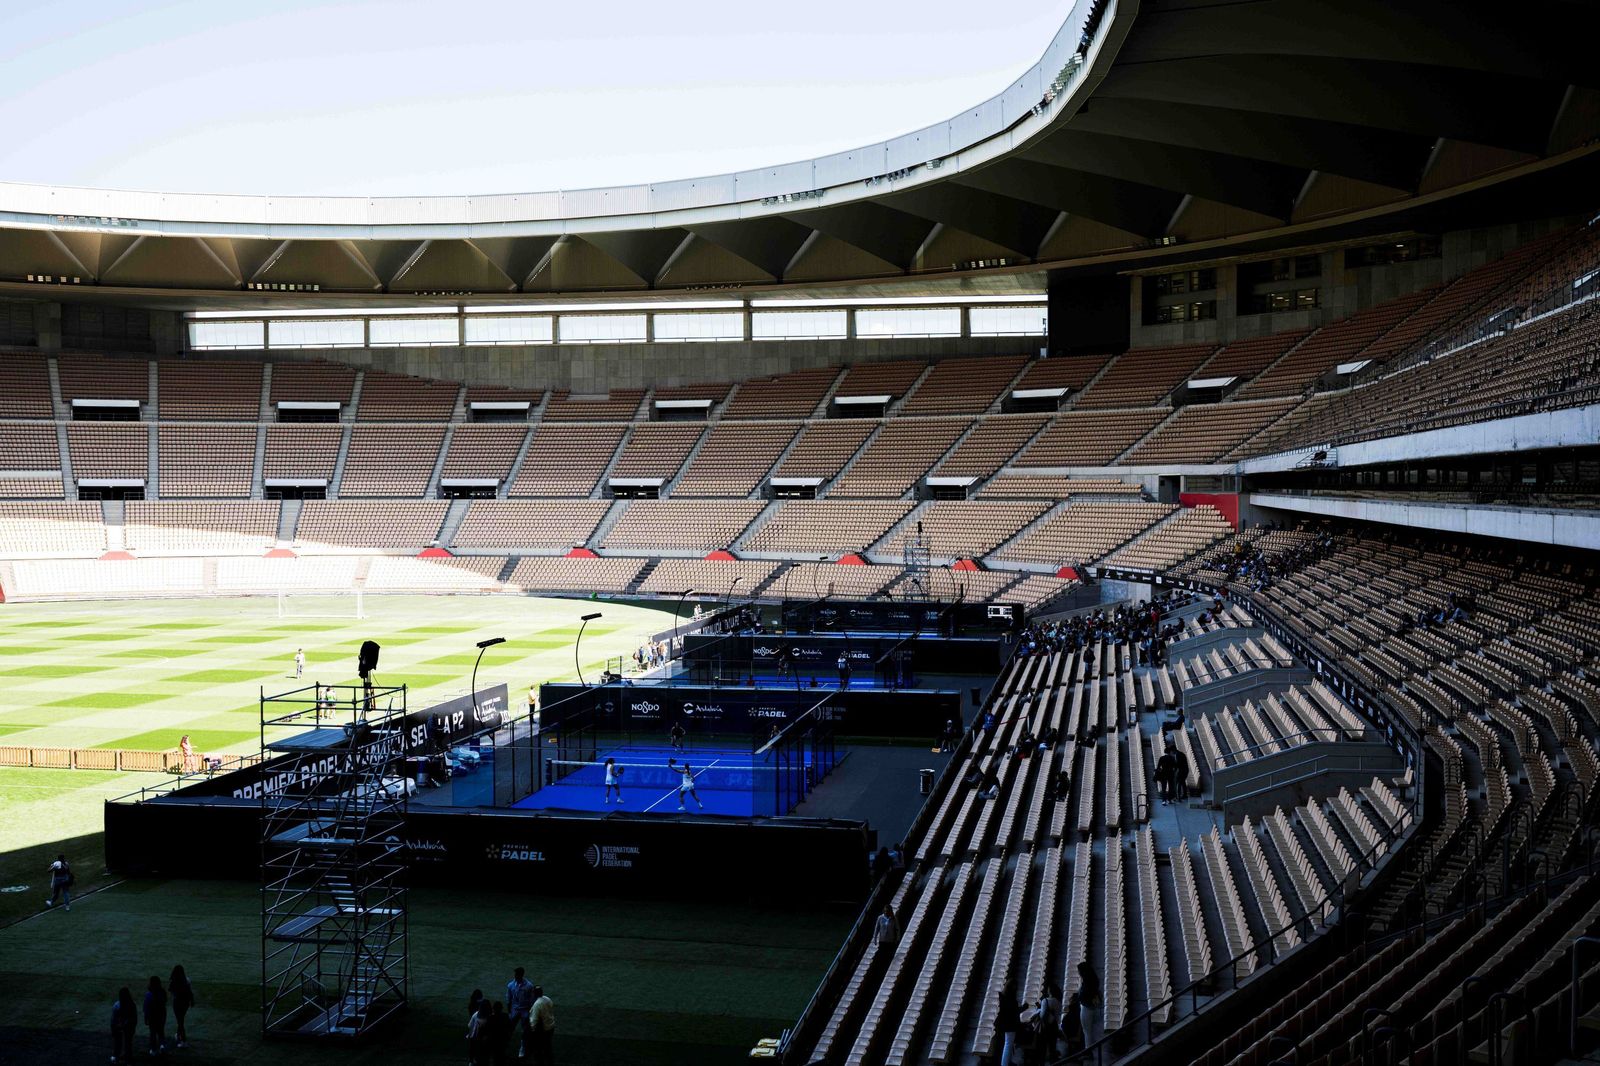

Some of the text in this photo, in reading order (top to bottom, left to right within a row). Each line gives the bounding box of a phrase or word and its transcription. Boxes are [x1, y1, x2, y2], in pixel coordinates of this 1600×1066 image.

[757, 710, 787, 718] PADEL
[301, 754, 342, 790] PADEL
[452, 710, 464, 732] P2
[619, 770, 711, 785] EVILA
[501, 850, 546, 861] PADEL
